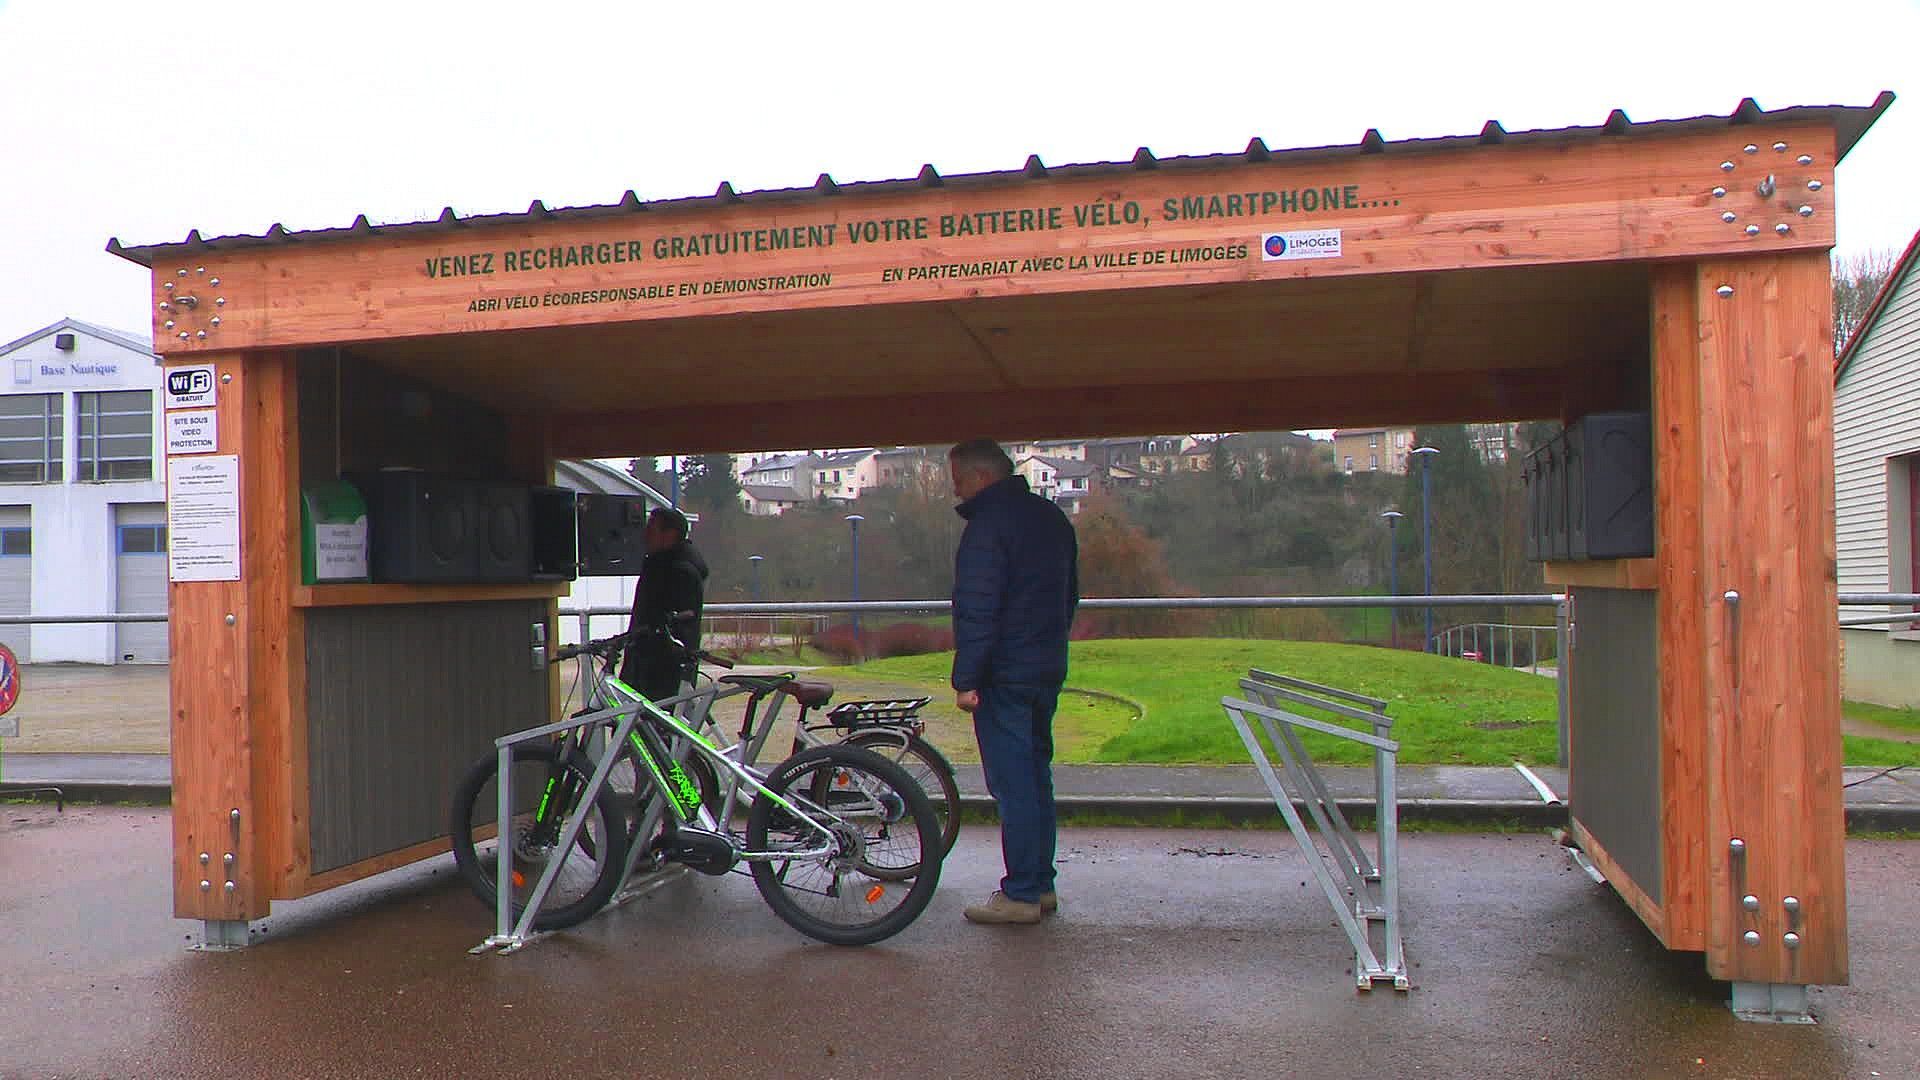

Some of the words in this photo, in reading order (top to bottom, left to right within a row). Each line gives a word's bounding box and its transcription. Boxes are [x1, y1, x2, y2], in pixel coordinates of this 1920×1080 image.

[425, 253, 495, 278] VENEZ
[504, 241, 642, 272] RECHARGER
[653, 224, 838, 260] GRATUITEMENT
[847, 217, 928, 244] VOTRE
[940, 207, 1063, 237] BATTERIE
[1073, 198, 1150, 229] VÉLO,
[1289, 237, 1338, 248] LIMOGES
[882, 269, 904, 281] EN
[907, 260, 1018, 281] PARTENARIAT
[1021, 257, 1064, 272] AVEC
[1068, 256, 1089, 269] LA
[1093, 252, 1138, 267] VILLE
[1142, 249, 1166, 265] DE
[1170, 245, 1248, 262] LIMOGES
[468, 299, 501, 312] ABRI
[543, 284, 676, 307] ÉCORESPONSABLE
[679, 283, 699, 297] EN
[703, 272, 832, 296] DÉMONSTRATION
[40, 364, 65, 376] Base
[71, 362, 117, 376] Nautique
[170, 440, 213, 448] PROTECTION
